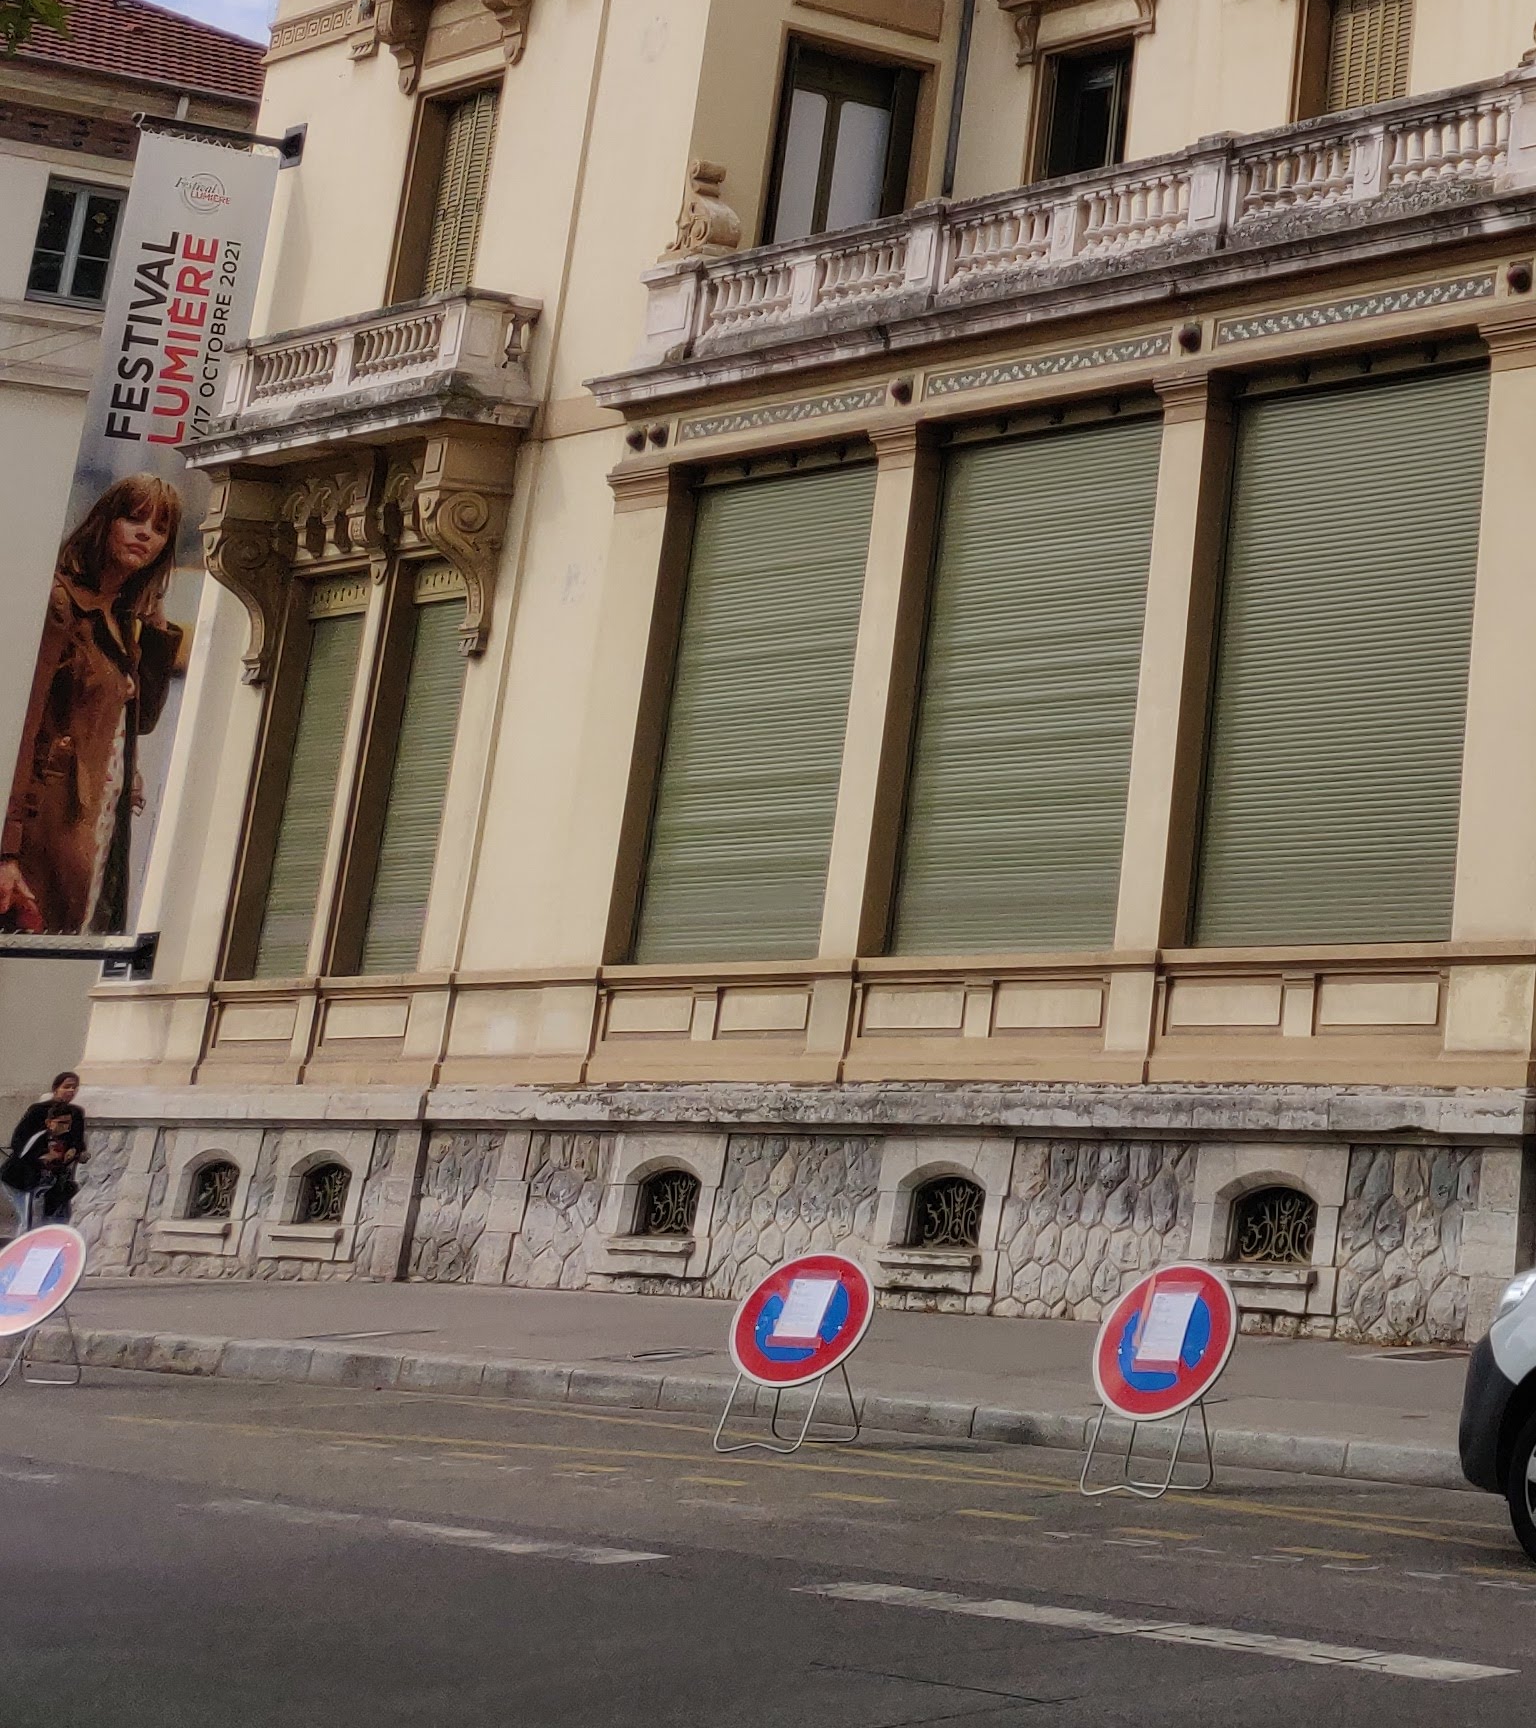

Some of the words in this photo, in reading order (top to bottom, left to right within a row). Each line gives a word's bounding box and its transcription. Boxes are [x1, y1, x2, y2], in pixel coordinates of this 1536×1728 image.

[219, 240, 242, 288] 2021
[104, 230, 180, 441] FESTIVAL
[147, 234, 219, 446] LUMIÈRE
[199, 294, 232, 398] OCTOBRE
[190, 407, 211, 441] /17
